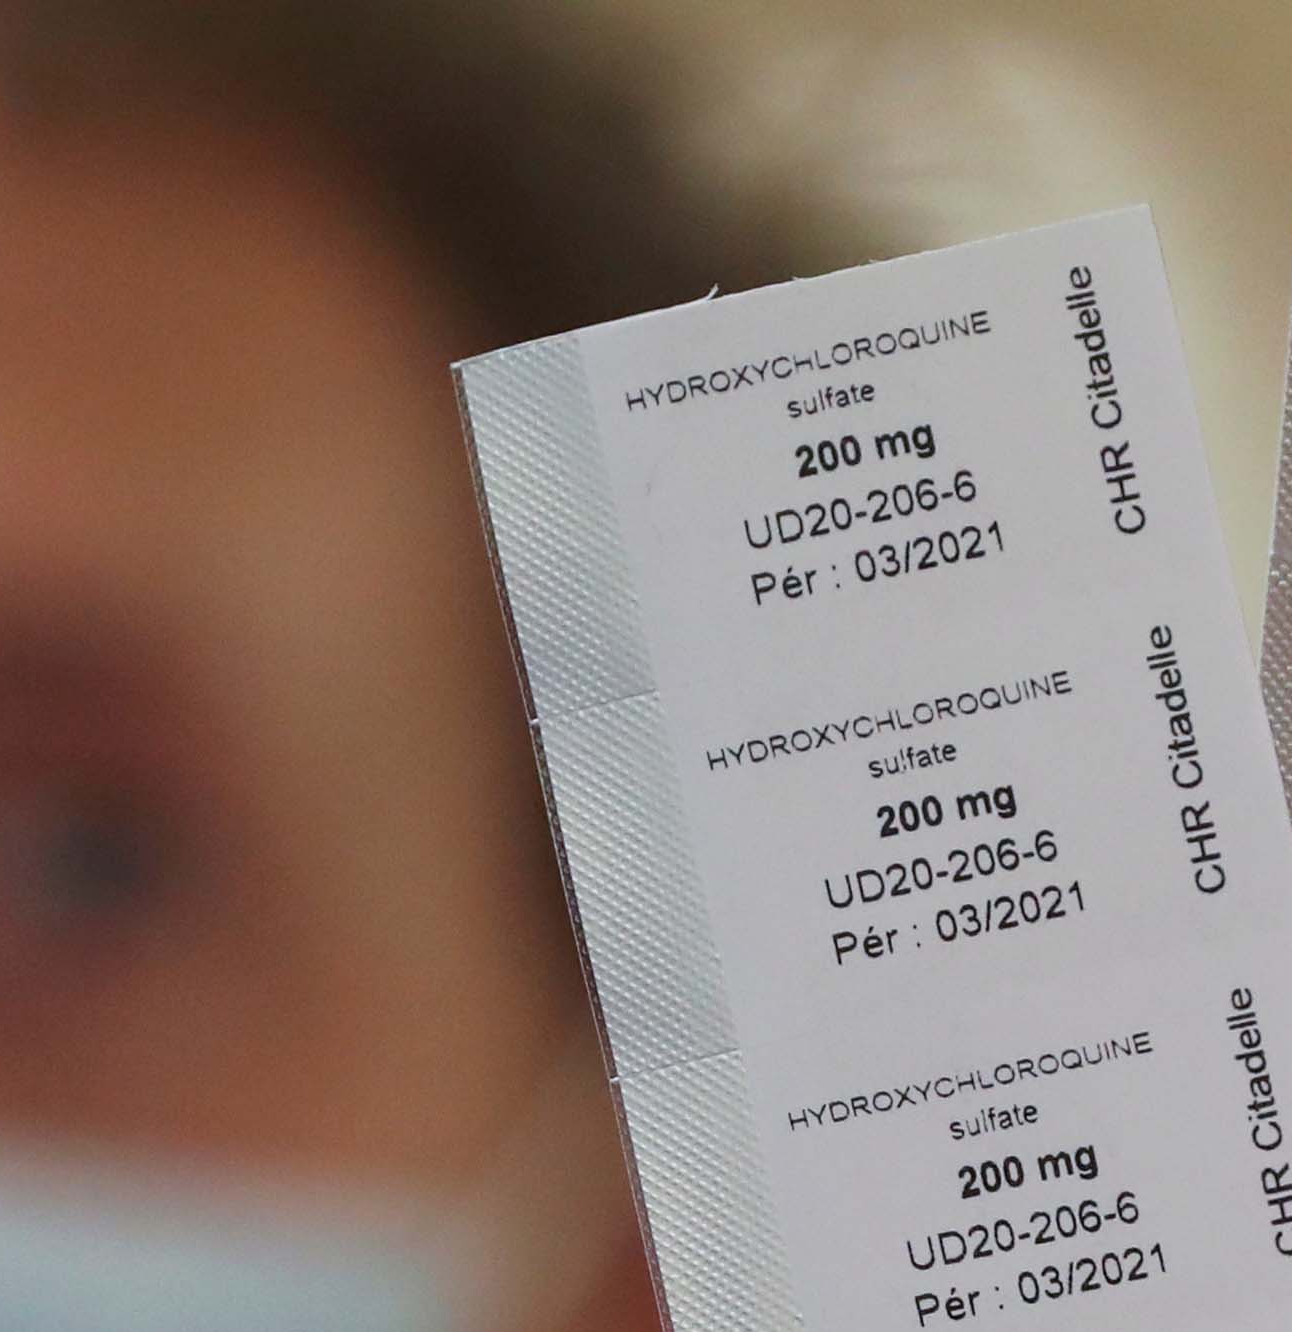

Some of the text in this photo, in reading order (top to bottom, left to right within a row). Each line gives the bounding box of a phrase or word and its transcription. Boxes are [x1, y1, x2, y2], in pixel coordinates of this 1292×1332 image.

[625, 309, 992, 412] HYDROXYCHLOROQUINE
[786, 383, 876, 419] sulfate
[1064, 265, 1147, 536] CHR Citadelle
[794, 423, 937, 479] 200 mg
[743, 468, 977, 550] UD20-206-6
[750, 565, 818, 607] Pér
[854, 519, 1004, 583] 03/2021
[706, 670, 1073, 772] HYDROXYCHLOROQUINE
[867, 743, 957, 780] sulfate
[1145, 624, 1227, 895] CHR Citadelle
[876, 784, 1018, 839] 200 mg
[823, 829, 1059, 910] UD20-206-6
[831, 925, 899, 966] Pér
[935, 879, 1085, 943] 03/2021
[787, 1031, 1154, 1132] HYDROXYCHLOROQUINE
[1225, 987, 1284, 1152] Citadelle
[948, 1103, 1039, 1141] sulfate
[957, 1144, 1099, 1200] 200 mg
[906, 1190, 1140, 1271] UD20-206-6
[914, 1286, 981, 1328] Pér
[1017, 1242, 1167, 1305] 03/2021
